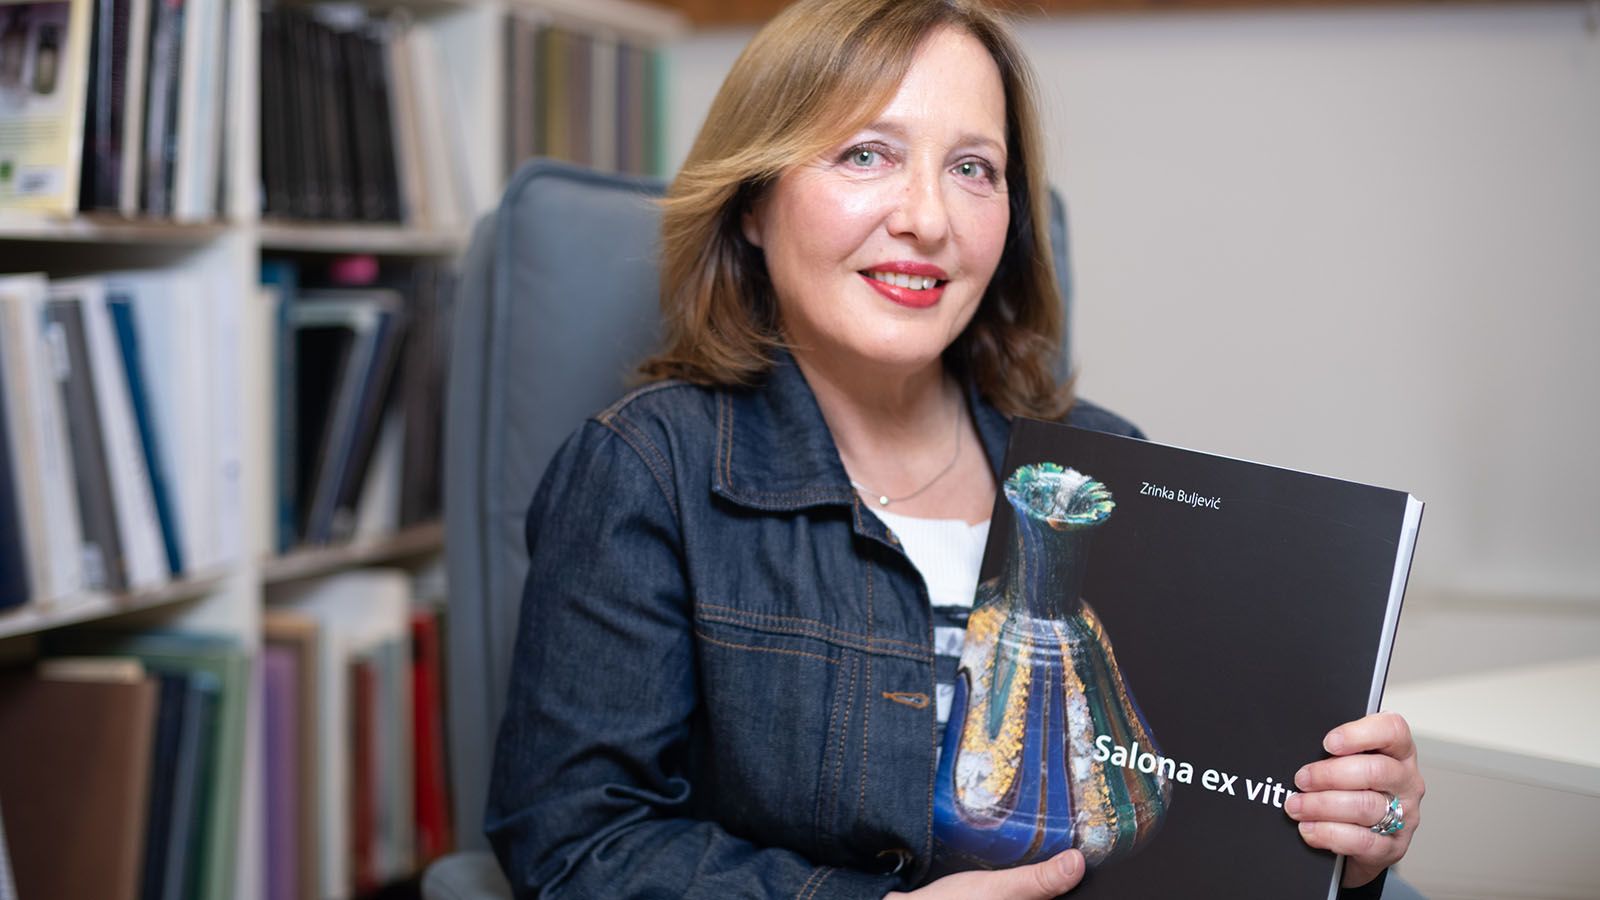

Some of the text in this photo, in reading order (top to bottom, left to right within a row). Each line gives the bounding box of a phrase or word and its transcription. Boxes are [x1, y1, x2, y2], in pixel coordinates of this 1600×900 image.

[1140, 481, 1221, 510] Zrinka Buljević
[1093, 734, 1194, 785] Salona
[1201, 768, 1239, 796] ex
